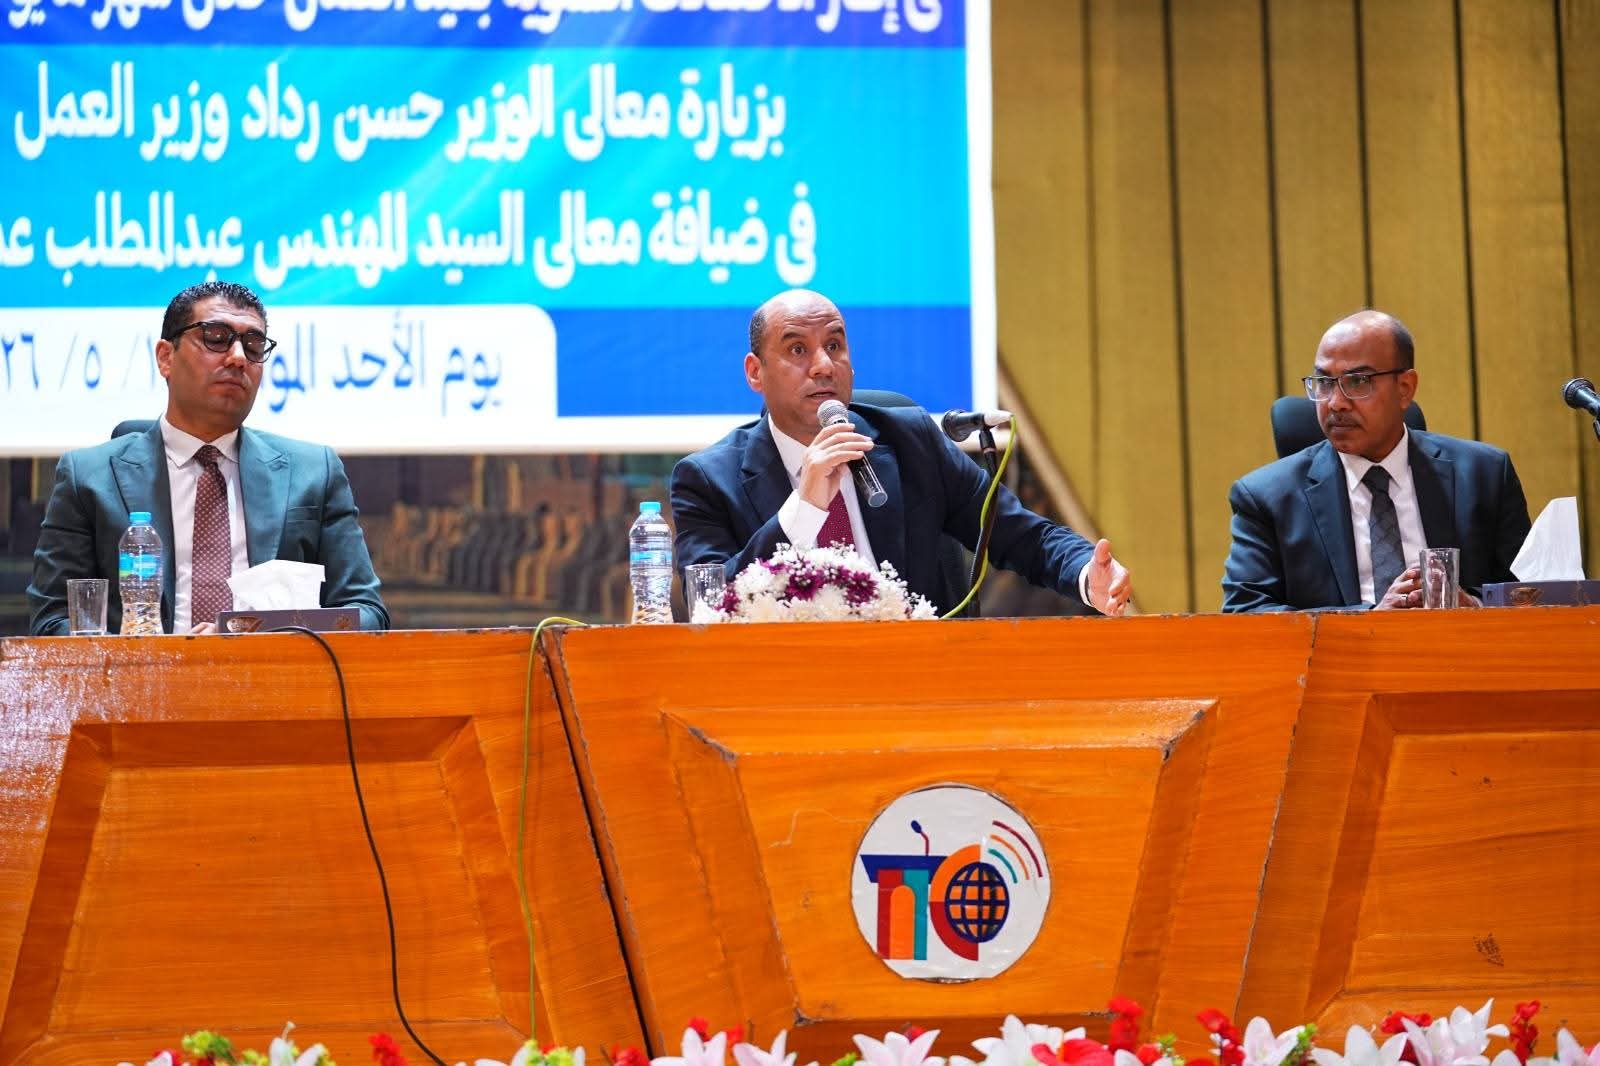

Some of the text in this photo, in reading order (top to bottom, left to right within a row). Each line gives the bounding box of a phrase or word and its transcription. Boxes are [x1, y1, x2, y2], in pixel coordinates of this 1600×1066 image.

[15, 62, 785, 162] بزيارة معالى الوزير حسن رداد وزير العمل
[254, 190, 408, 289] المهندس
[416, 190, 524, 284] السيد
[534, 190, 641, 289] معالى
[649, 187, 768, 283] ضيافة
[775, 183, 816, 286] فى
[332, 308, 426, 389] الأحد
[440, 347, 502, 417] يوم
